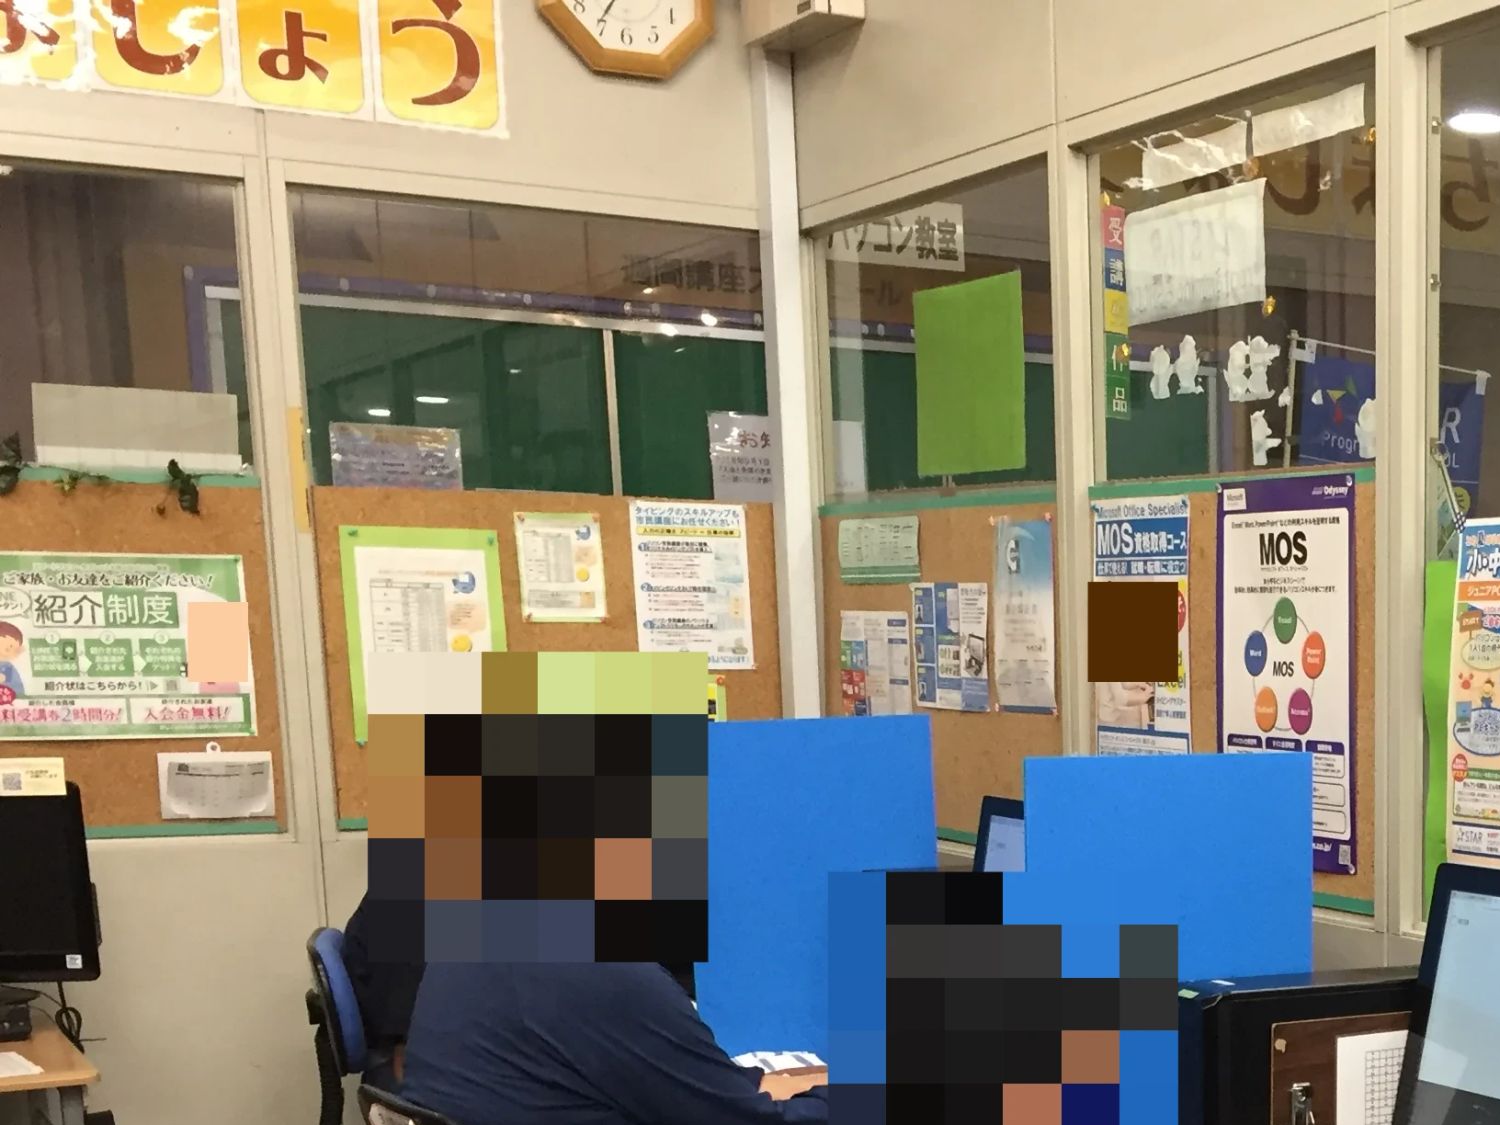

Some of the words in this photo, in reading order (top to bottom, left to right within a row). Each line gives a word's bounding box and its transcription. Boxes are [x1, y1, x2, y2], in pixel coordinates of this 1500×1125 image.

[620, 27, 633, 46] 6
[647, 26, 659, 44] 5
[635, 505, 740, 519] タイピングのスキルアップも
[635, 514, 741, 528] 市民講座にお任せください！
[1259, 530, 1308, 566] MOS
[4, 569, 214, 588] ご家族・お友達をご紹介ください！
[34, 593, 175, 626] 紹介制度
[1272, 661, 1295, 678] MOS
[44, 681, 143, 692] 紹介状はこちらから！
[0, 705, 123, 723] 料受講券2時間分！
[144, 706, 231, 722] 入会金無料！
